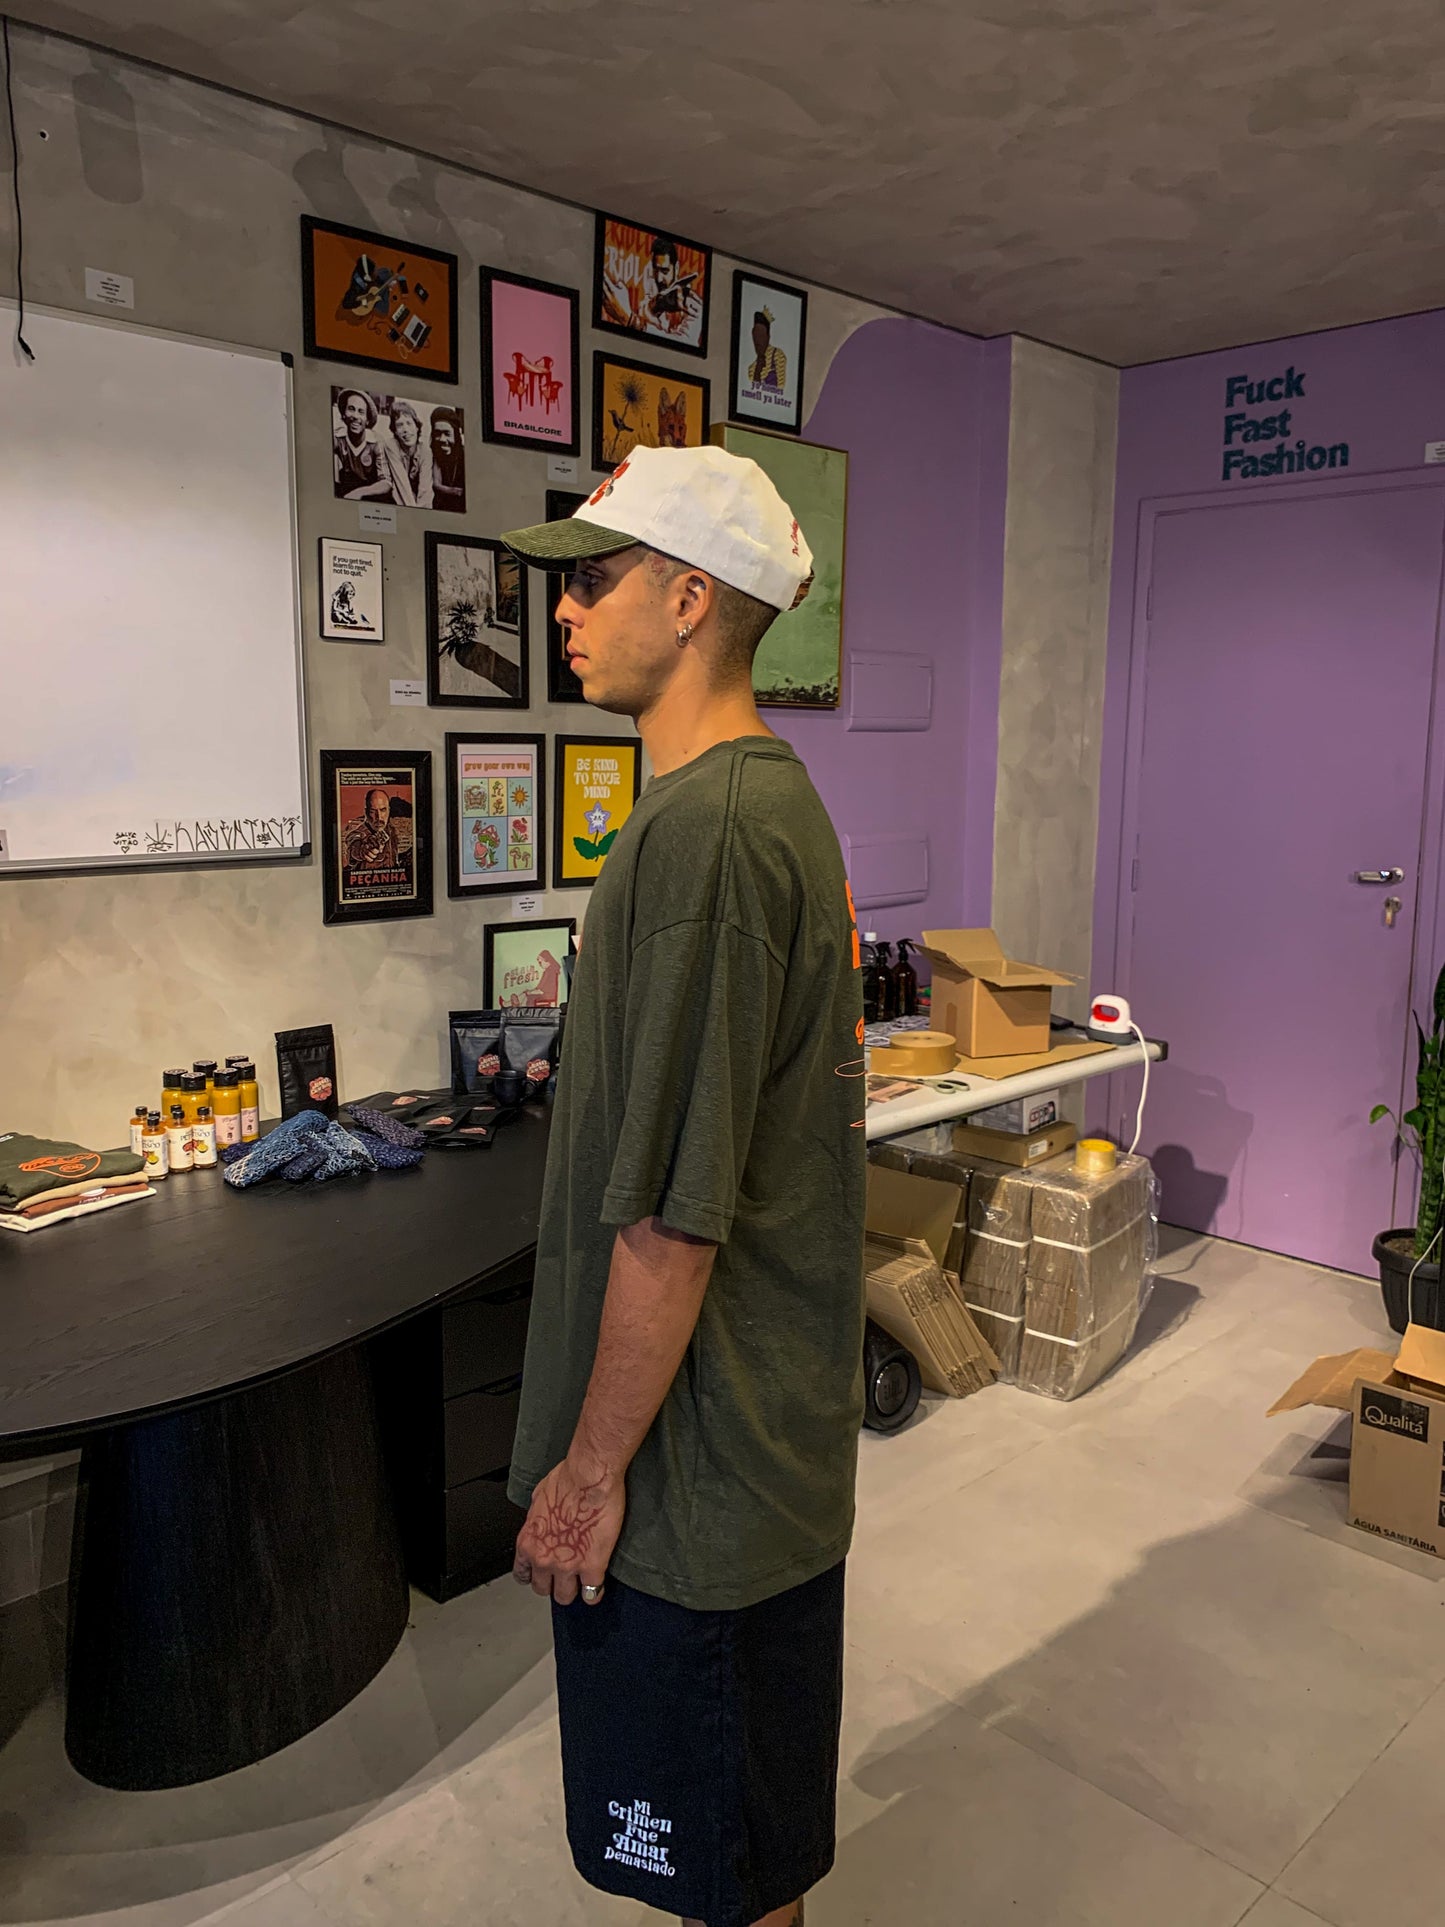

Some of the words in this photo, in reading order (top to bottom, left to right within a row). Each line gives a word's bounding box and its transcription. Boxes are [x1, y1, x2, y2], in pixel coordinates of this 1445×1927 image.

[1225, 366, 1306, 408] Fuck
[763, 395, 772, 404] ya
[774, 395, 791, 408] later
[503, 421, 562, 436] BRASILCORE
[1223, 409, 1291, 445] Fast
[1221, 440, 1349, 481] Fashion
[464, 762, 482, 772] grow
[484, 762, 499, 772] your
[517, 762, 530, 772] way
[576, 758, 591, 771] BE
[593, 758, 618, 771] KIND
[573, 772, 589, 785] TO
[592, 772, 620, 785] YOUR
[584, 786, 610, 799] MIND
[350, 873, 407, 886] PEÇANHA
[504, 970, 539, 989] fresh
[1365, 1405, 1424, 1435] Qualitá
[1384, 1528, 1437, 1553] SANITÁRIA
[608, 1800, 672, 1833] Crimen
[633, 1799, 651, 1816] Mi
[625, 1821, 658, 1843] Fue
[613, 1833, 669, 1861] Amar
[604, 1846, 675, 1877] Demasiado
